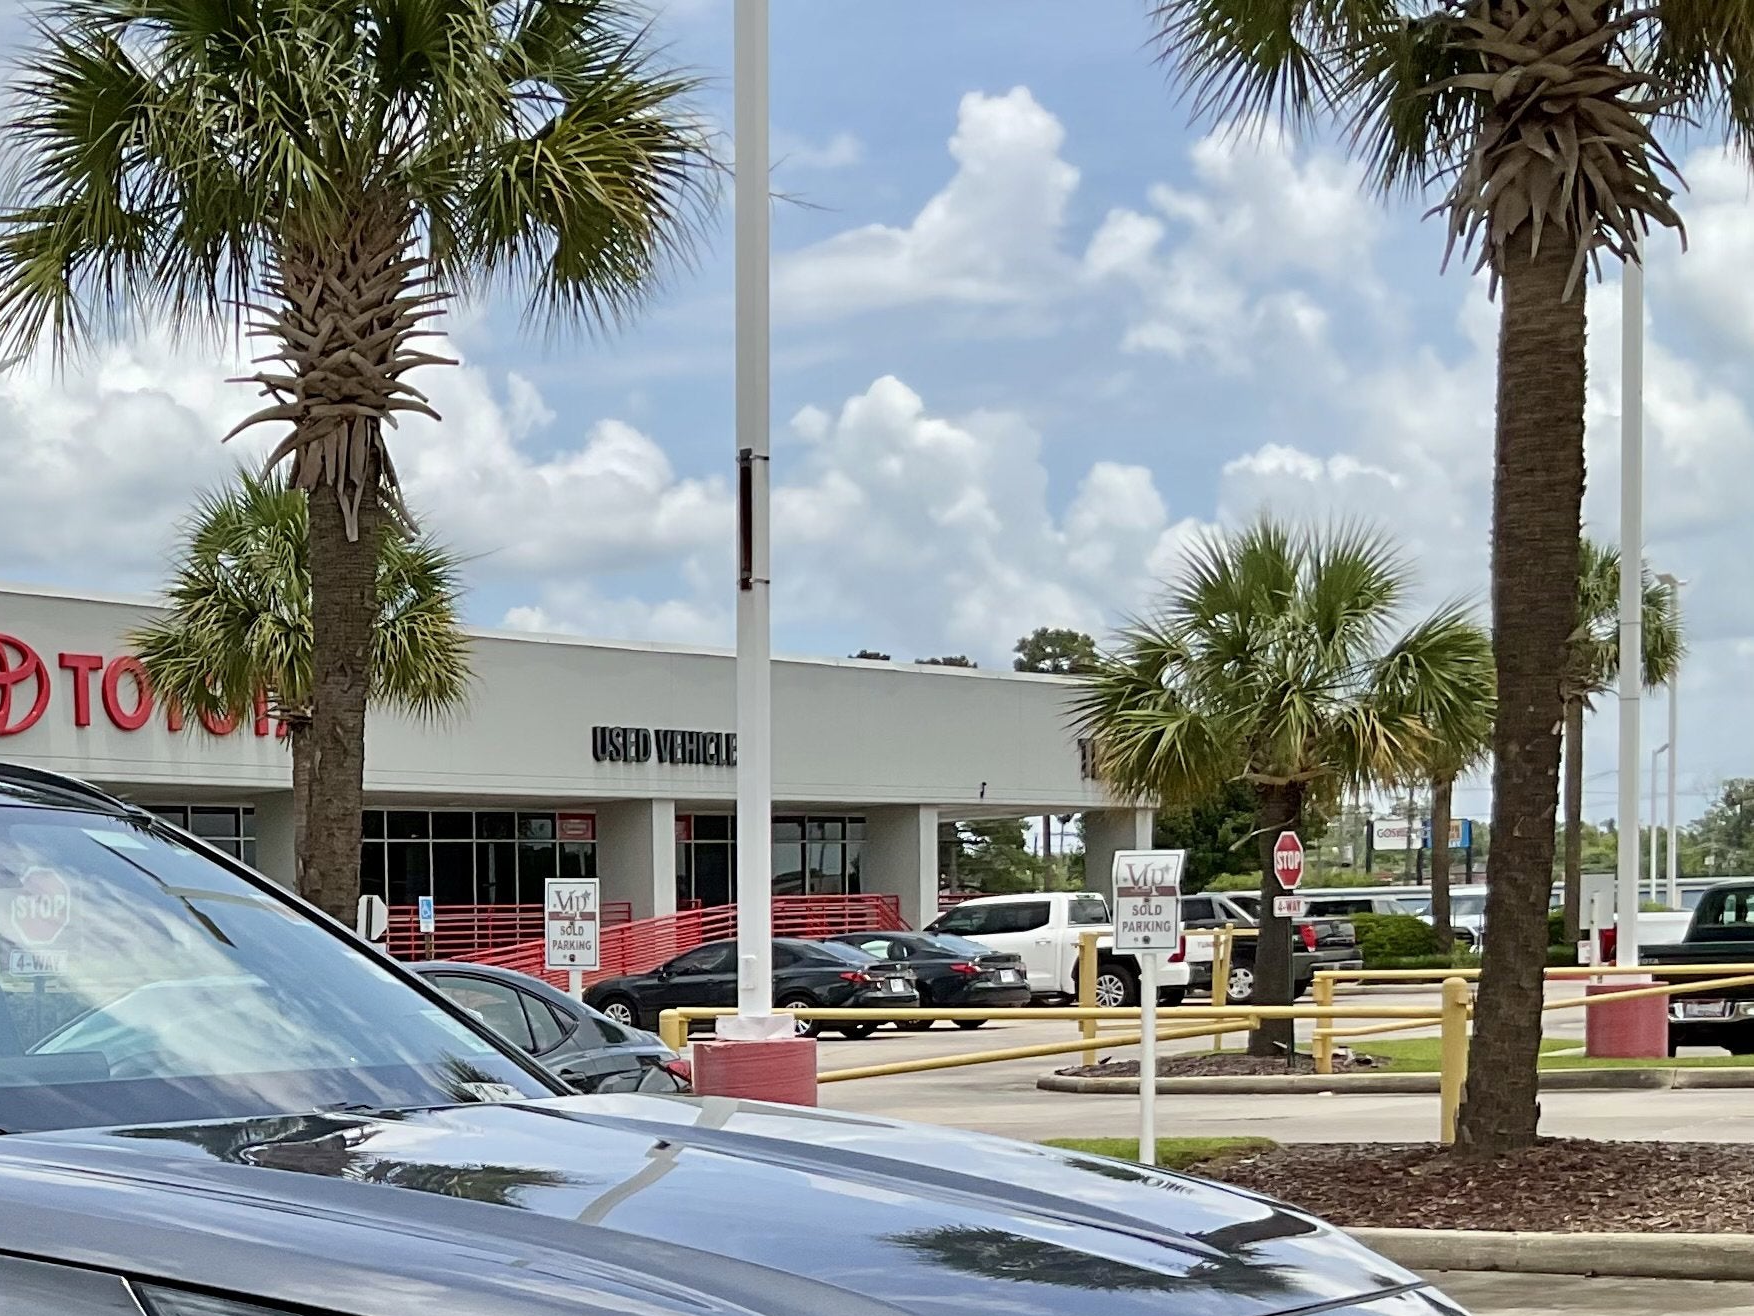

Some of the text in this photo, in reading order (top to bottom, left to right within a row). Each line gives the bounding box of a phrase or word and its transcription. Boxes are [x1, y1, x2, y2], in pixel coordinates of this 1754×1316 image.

[592, 726, 737, 767] USED VEHICLE
[1276, 851, 1301, 870] STOP
[15, 894, 66, 919] STOP
[1132, 904, 1163, 916] SOLD
[1277, 901, 1302, 912] 4-WAY
[560, 925, 584, 936] SOLD
[1122, 921, 1172, 933] PARKING
[552, 940, 592, 951] PARKING
